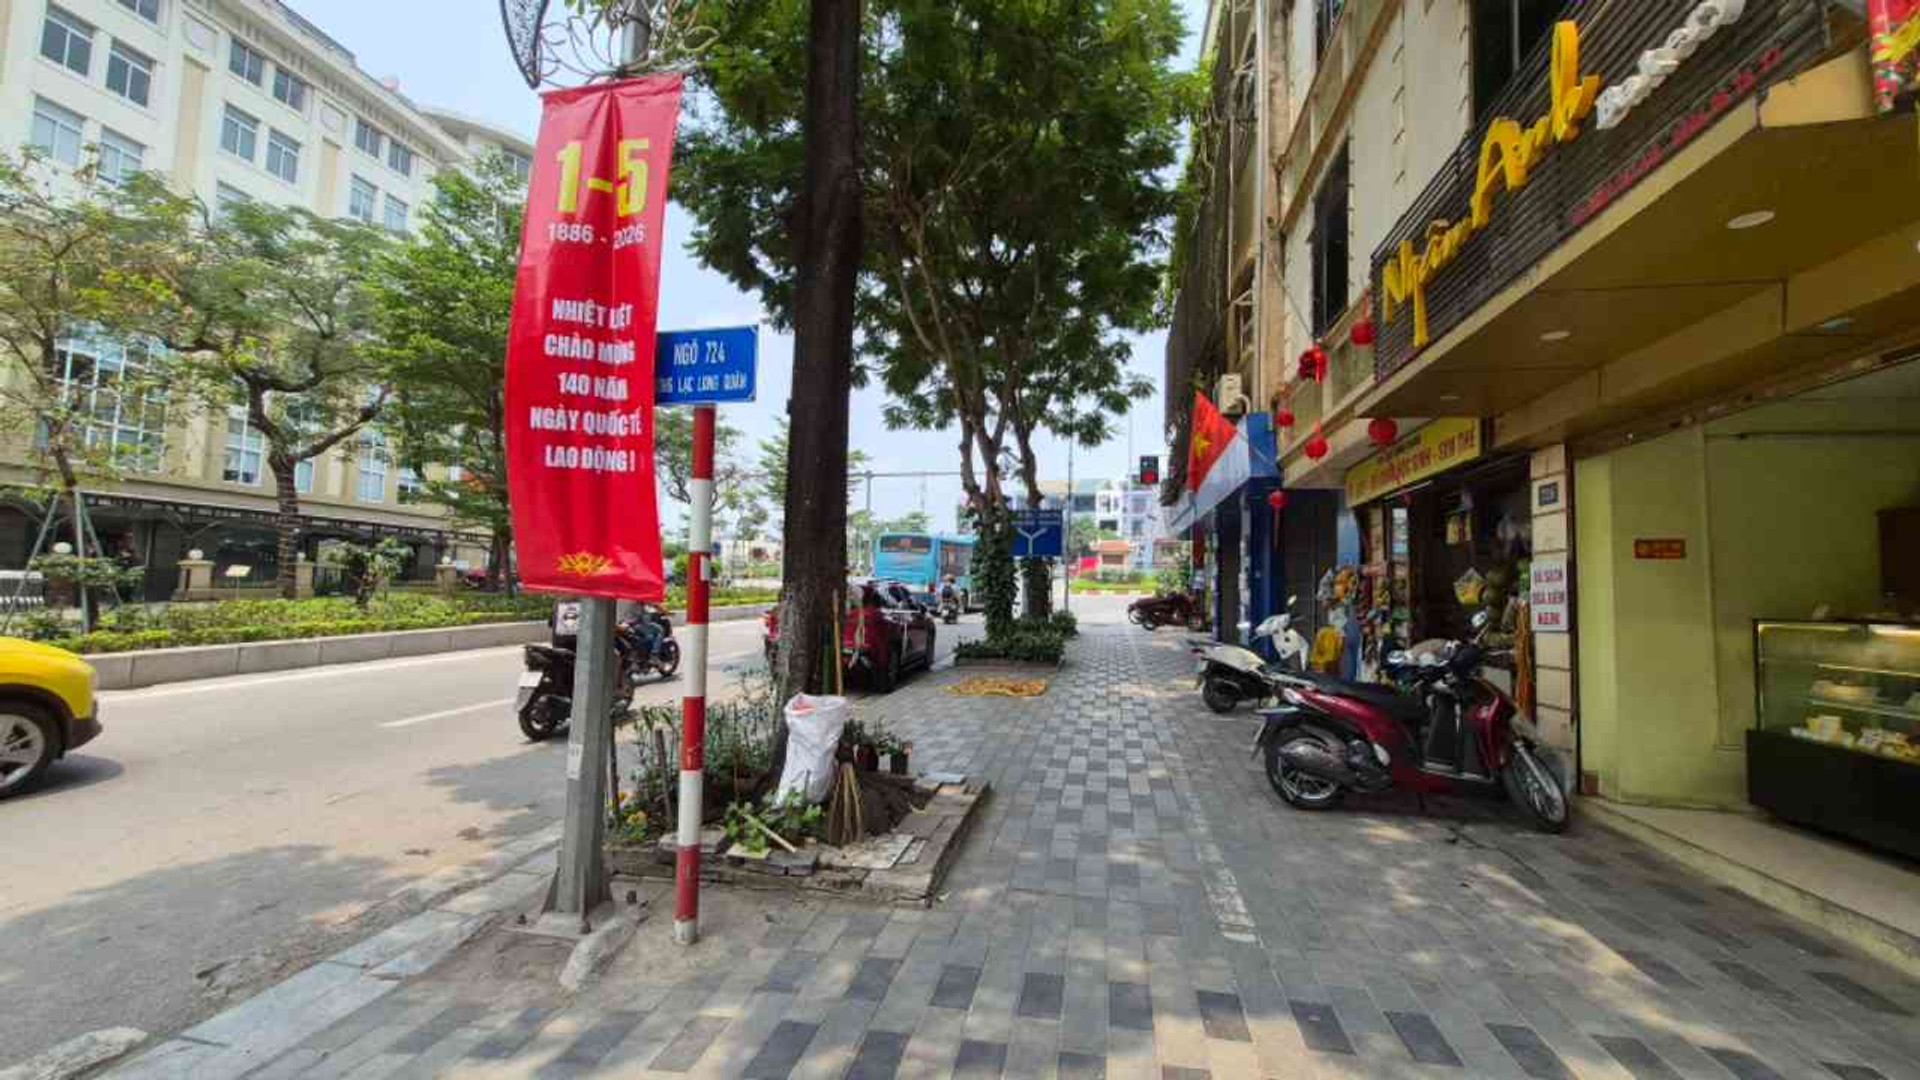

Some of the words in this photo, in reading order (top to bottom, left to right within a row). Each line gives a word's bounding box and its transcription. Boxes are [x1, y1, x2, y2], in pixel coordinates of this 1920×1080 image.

[1470, 20, 1603, 229] Anh
[548, 222, 594, 244] 1886
[552, 298, 607, 328] NHIỆT
[544, 332, 595, 360] CHÀO
[706, 340, 726, 364] 724
[557, 371, 591, 396] 140
[530, 402, 580, 431] NGÀY
[582, 408, 629, 436] QUỐC
[545, 444, 579, 469] LAO
